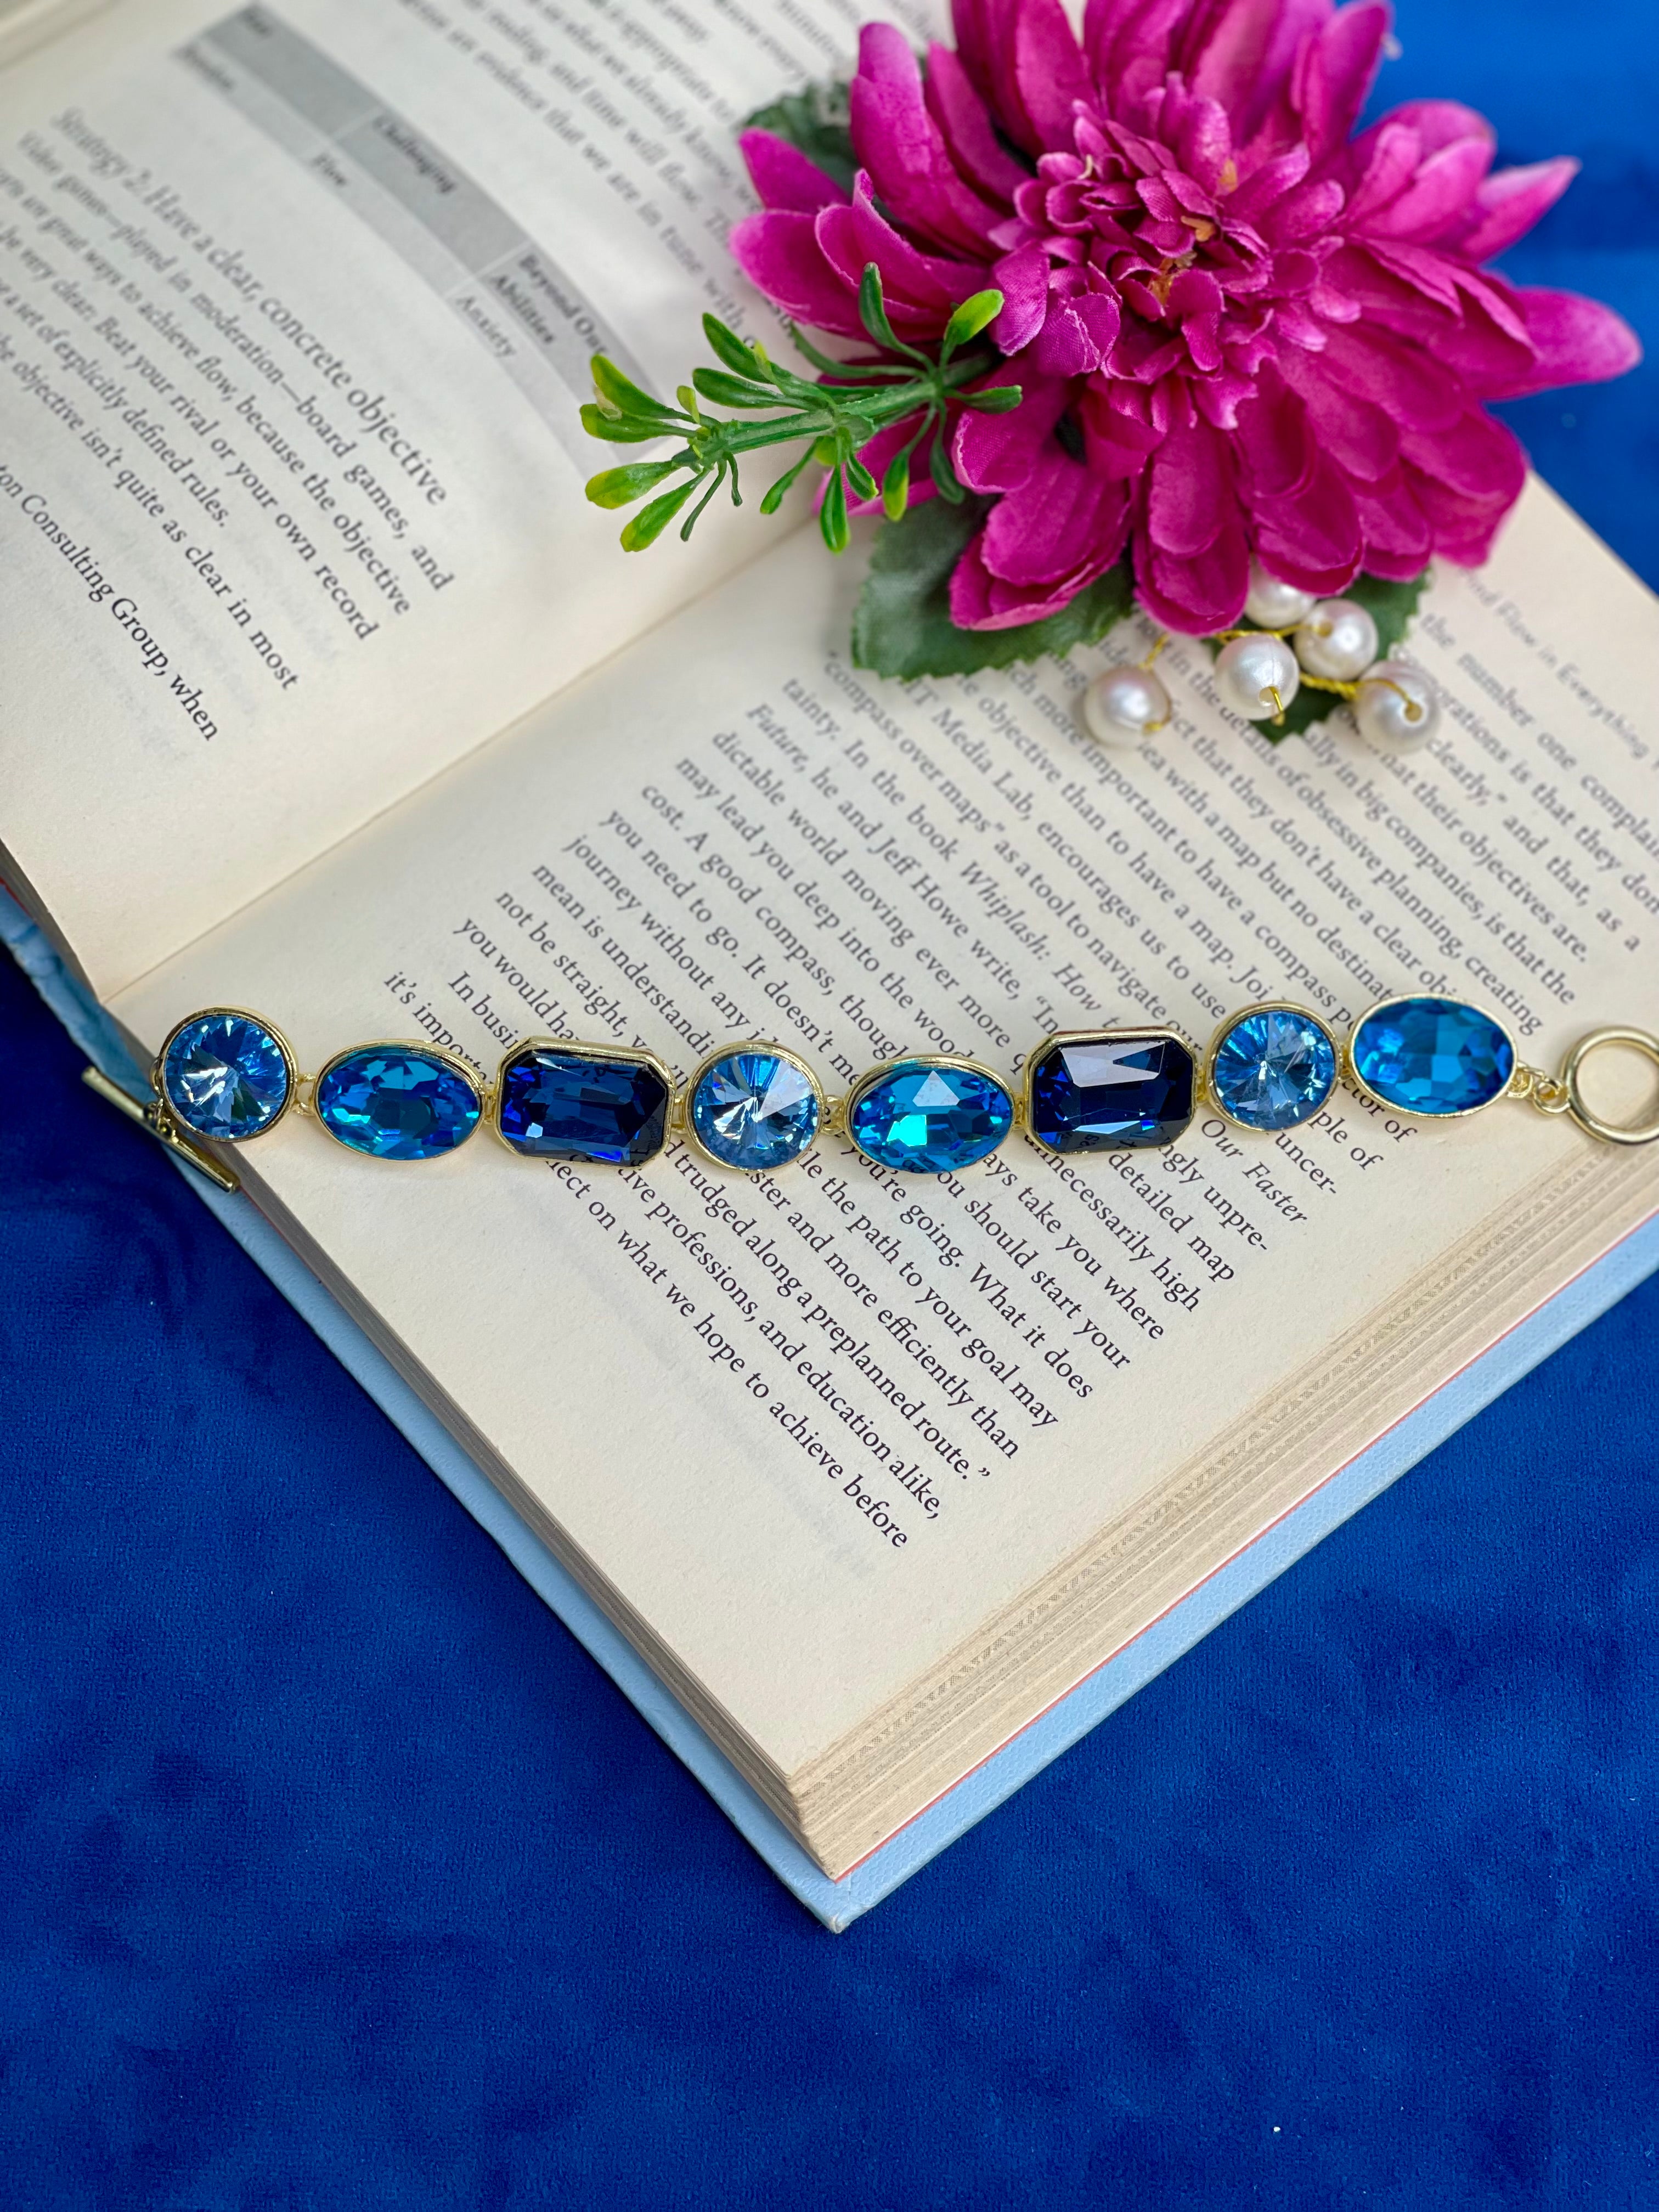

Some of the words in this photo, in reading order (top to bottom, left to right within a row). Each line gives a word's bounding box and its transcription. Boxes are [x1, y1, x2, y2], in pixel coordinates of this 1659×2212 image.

[51, 340, 131, 412] explicitly
[120, 407, 196, 477] defined
[178, 470, 231, 529] rules.
[205, 247, 265, 304] clear,
[257, 296, 354, 391] concrete
[344, 387, 448, 507] objective
[453, 294, 518, 359] Anxiety
[486, 273, 558, 347] Abilities
[515, 251, 585, 321] Beyond
[702, 275, 748, 332] with
[9, 360, 86, 433] objective
[78, 426, 125, 471] isn’t
[111, 467, 167, 520] quite
[160, 518, 189, 545] as
[183, 545, 234, 600] clear
[225, 596, 253, 630] in
[246, 628, 301, 692] most
[91, 314, 139, 359] Beat
[122, 353, 177, 397] your
[166, 393, 222, 439] rival
[208, 436, 238, 462] or
[223, 459, 280, 511] your
[273, 511, 319, 565] own
[311, 562, 382, 642] record
[136, 300, 202, 362] achieve
[193, 354, 240, 404] flow,
[233, 392, 307, 476] because
[300, 471, 338, 514] the
[331, 512, 411, 617] objective
[341, 462, 410, 541] games,
[409, 544, 457, 593] and
[19, 492, 117, 605] Consulting
[109, 596, 173, 678] Group,
[168, 670, 219, 743] when
[1456, 652, 1536, 728] number
[744, 702, 810, 774] Future,
[865, 834, 923, 878] Jeff
[908, 871, 970, 940] Howe
[969, 937, 1022, 1001] write,
[1030, 994, 1060, 1039] “In
[1202, 1184, 1269, 1251] unpre-
[781, 677, 842, 742] tainty.
[870, 768, 907, 807] the
[905, 802, 960, 864] book
[958, 859, 1052, 962] Whiplash:
[1049, 961, 1103, 1012] How
[1200, 1111, 1245, 1159] Our
[1240, 1160, 1309, 1226] Faster
[898, 737, 945, 783] over
[1026, 872, 1077, 920] tool
[1085, 936, 1168, 1029] navigate
[1273, 1128, 1338, 1195] uncer-
[930, 707, 994, 776] Media
[991, 769, 1035, 822] Lab,
[1035, 820, 1142, 929] encourages
[1189, 980, 1227, 1020] use
[1348, 1146, 1386, 1172] of
[977, 697, 1063, 785] objective
[1059, 781, 1108, 833] than
[1126, 849, 1177, 905] have
[1187, 917, 1236, 971] map.
[1227, 963, 1275, 1007] Joi
[1383, 1110, 1420, 1144] of
[1086, 749, 1178, 844] important
[1193, 856, 1244, 912] have
[1253, 924, 1339, 1009] compass
[1164, 766, 1210, 816] with
[1214, 823, 1263, 870] map
[1256, 859, 1296, 904] but
[1228, 773, 1276, 820] they
[1268, 817, 1322, 870] don’t
[1313, 859, 1364, 912] have
[1371, 923, 1424, 972] clear
[1295, 785, 1384, 872] obsessive
[1369, 866, 1465, 961] planning,
[1463, 955, 1545, 1038] creating
[1353, 778, 1391, 823] big
[1383, 814, 1486, 922] companies,
[1500, 929, 1547, 976] that
[1410, 780, 1464, 832] their
[1457, 829, 1557, 927] objectives
[1550, 922, 1588, 964] are.
[1544, 854, 1592, 908] that,
[1573, 824, 1624, 873] they
[530, 863, 587, 922] mean
[820, 1176, 857, 1217] the
[844, 1212, 904, 1266] path
[913, 1285, 973, 1339] your
[960, 1337, 1022, 1386] goal
[1007, 1379, 1060, 1438] may
[560, 833, 644, 913] journey
[639, 910, 716, 992] without
[709, 990, 752, 1030] any
[898, 1203, 966, 1269] going.
[968, 1260, 1028, 1330] What
[1020, 1324, 1047, 1350] it
[1042, 1346, 1094, 1400] does
[597, 809, 645, 851] you
[639, 848, 699, 901] need
[703, 924, 741, 960] go.
[762, 979, 835, 1054] doesn’t
[962, 1199, 1041, 1271] should
[1029, 1269, 1084, 1321] start
[1071, 1317, 1132, 1370] your
[640, 785, 685, 833] cost.
[697, 851, 765, 906] good
[754, 905, 837, 997] compass,
[1016, 1185, 1063, 1235] take
[1054, 1231, 1105, 1278] you
[1102, 1274, 1165, 1341] where
[674, 757, 723, 801] may
[714, 792, 767, 844] lead
[748, 839, 796, 883] you
[791, 879, 842, 932] deep
[836, 925, 882, 973] into
[1149, 1255, 1203, 1314] high
[710, 730, 787, 808] dictable
[786, 806, 850, 868] world
[839, 867, 917, 950] moving
[913, 946, 961, 992] ever
[956, 992, 1012, 1049] more
[1107, 1143, 1195, 1235] detailed
[1185, 1234, 1236, 1284] map
[382, 970, 419, 1006] it’s
[616, 1228, 669, 1286] what
[664, 1281, 697, 1319] we
[690, 1311, 747, 1374] hope
[768, 1398, 845, 1481] achieve
[841, 1472, 909, 1549] before
[446, 969, 476, 1005] In
[642, 1200, 760, 1324] professions,
[757, 1318, 809, 1364] and
[795, 1360, 893, 1464] education
[887, 1459, 945, 1521] alike,
[450, 916, 506, 963] you
[493, 956, 561, 1020] would
[673, 1145, 759, 1239] trudged
[743, 1233, 804, 1299] along
[799, 1302, 928, 1422] preplanned
[911, 1415, 992, 1481] route.”
[493, 890, 535, 930] not
[527, 919, 557, 956] be
[551, 953, 629, 1039] straight,
[786, 1210, 837, 1257] and
[822, 1249, 879, 1309] more
[872, 1307, 976, 1408] efficiently
[969, 1404, 1020, 1461] than
